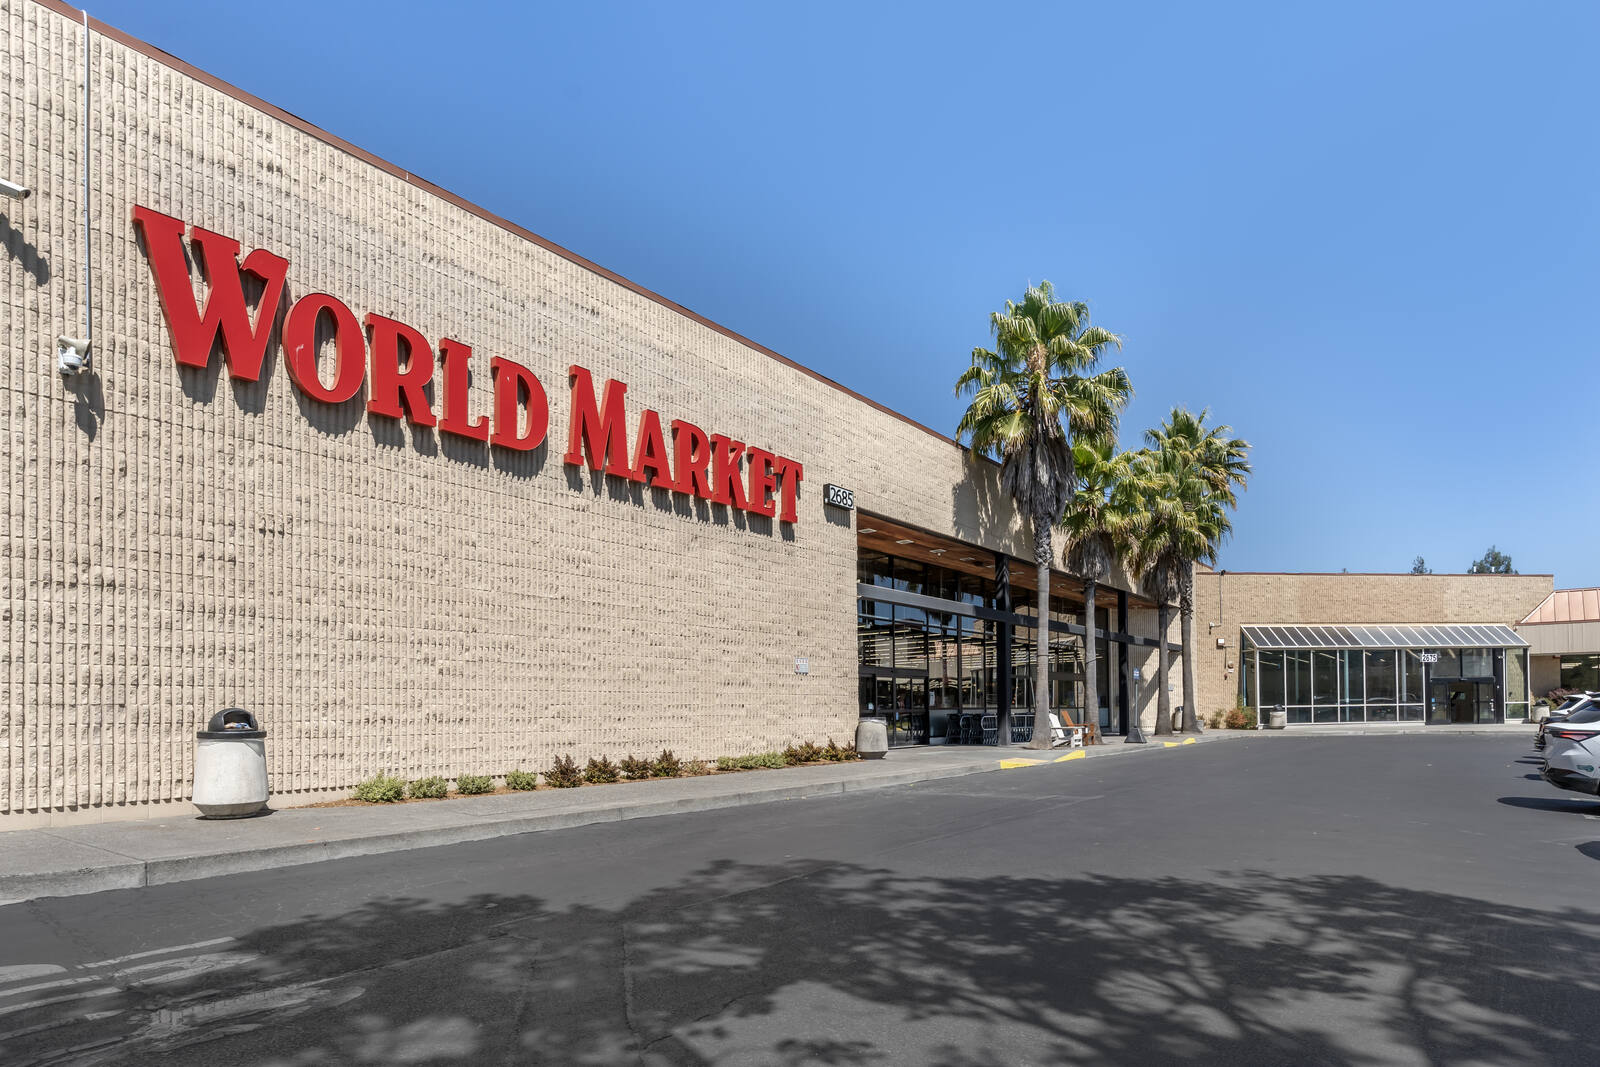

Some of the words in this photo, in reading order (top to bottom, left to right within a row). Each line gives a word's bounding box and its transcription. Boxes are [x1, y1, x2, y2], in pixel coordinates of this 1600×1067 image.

[134, 205, 548, 451] WORLD
[564, 365, 804, 524] MARKET
[830, 487, 854, 507] 2685
[1422, 654, 1437, 662] 2675
